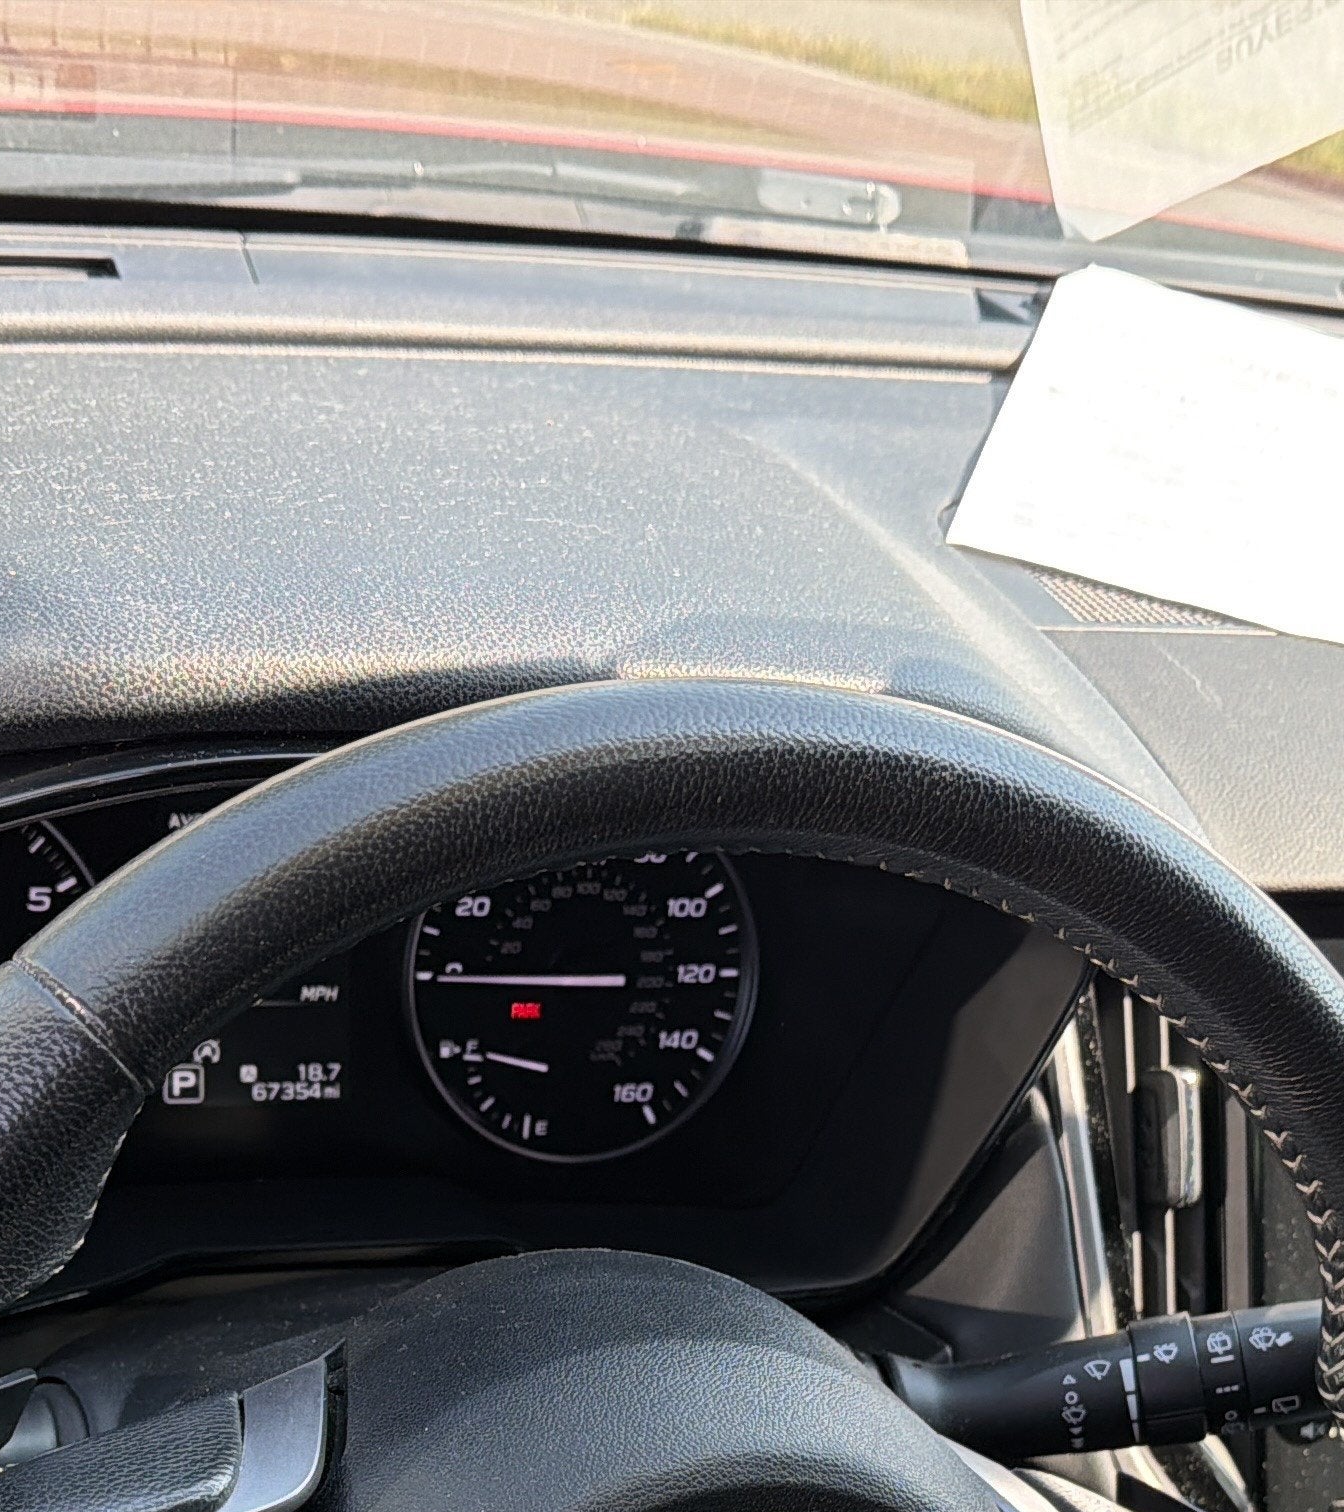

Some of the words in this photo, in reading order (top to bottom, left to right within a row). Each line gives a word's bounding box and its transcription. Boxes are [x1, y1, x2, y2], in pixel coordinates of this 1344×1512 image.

[26, 886, 52, 912] 5
[455, 895, 492, 918] 20
[666, 897, 707, 918] 100
[677, 963, 717, 984] 120
[300, 984, 340, 1002] MPH
[658, 1029, 700, 1050] 140
[298, 1061, 342, 1082] 18.7
[612, 1083, 654, 1104] 160
